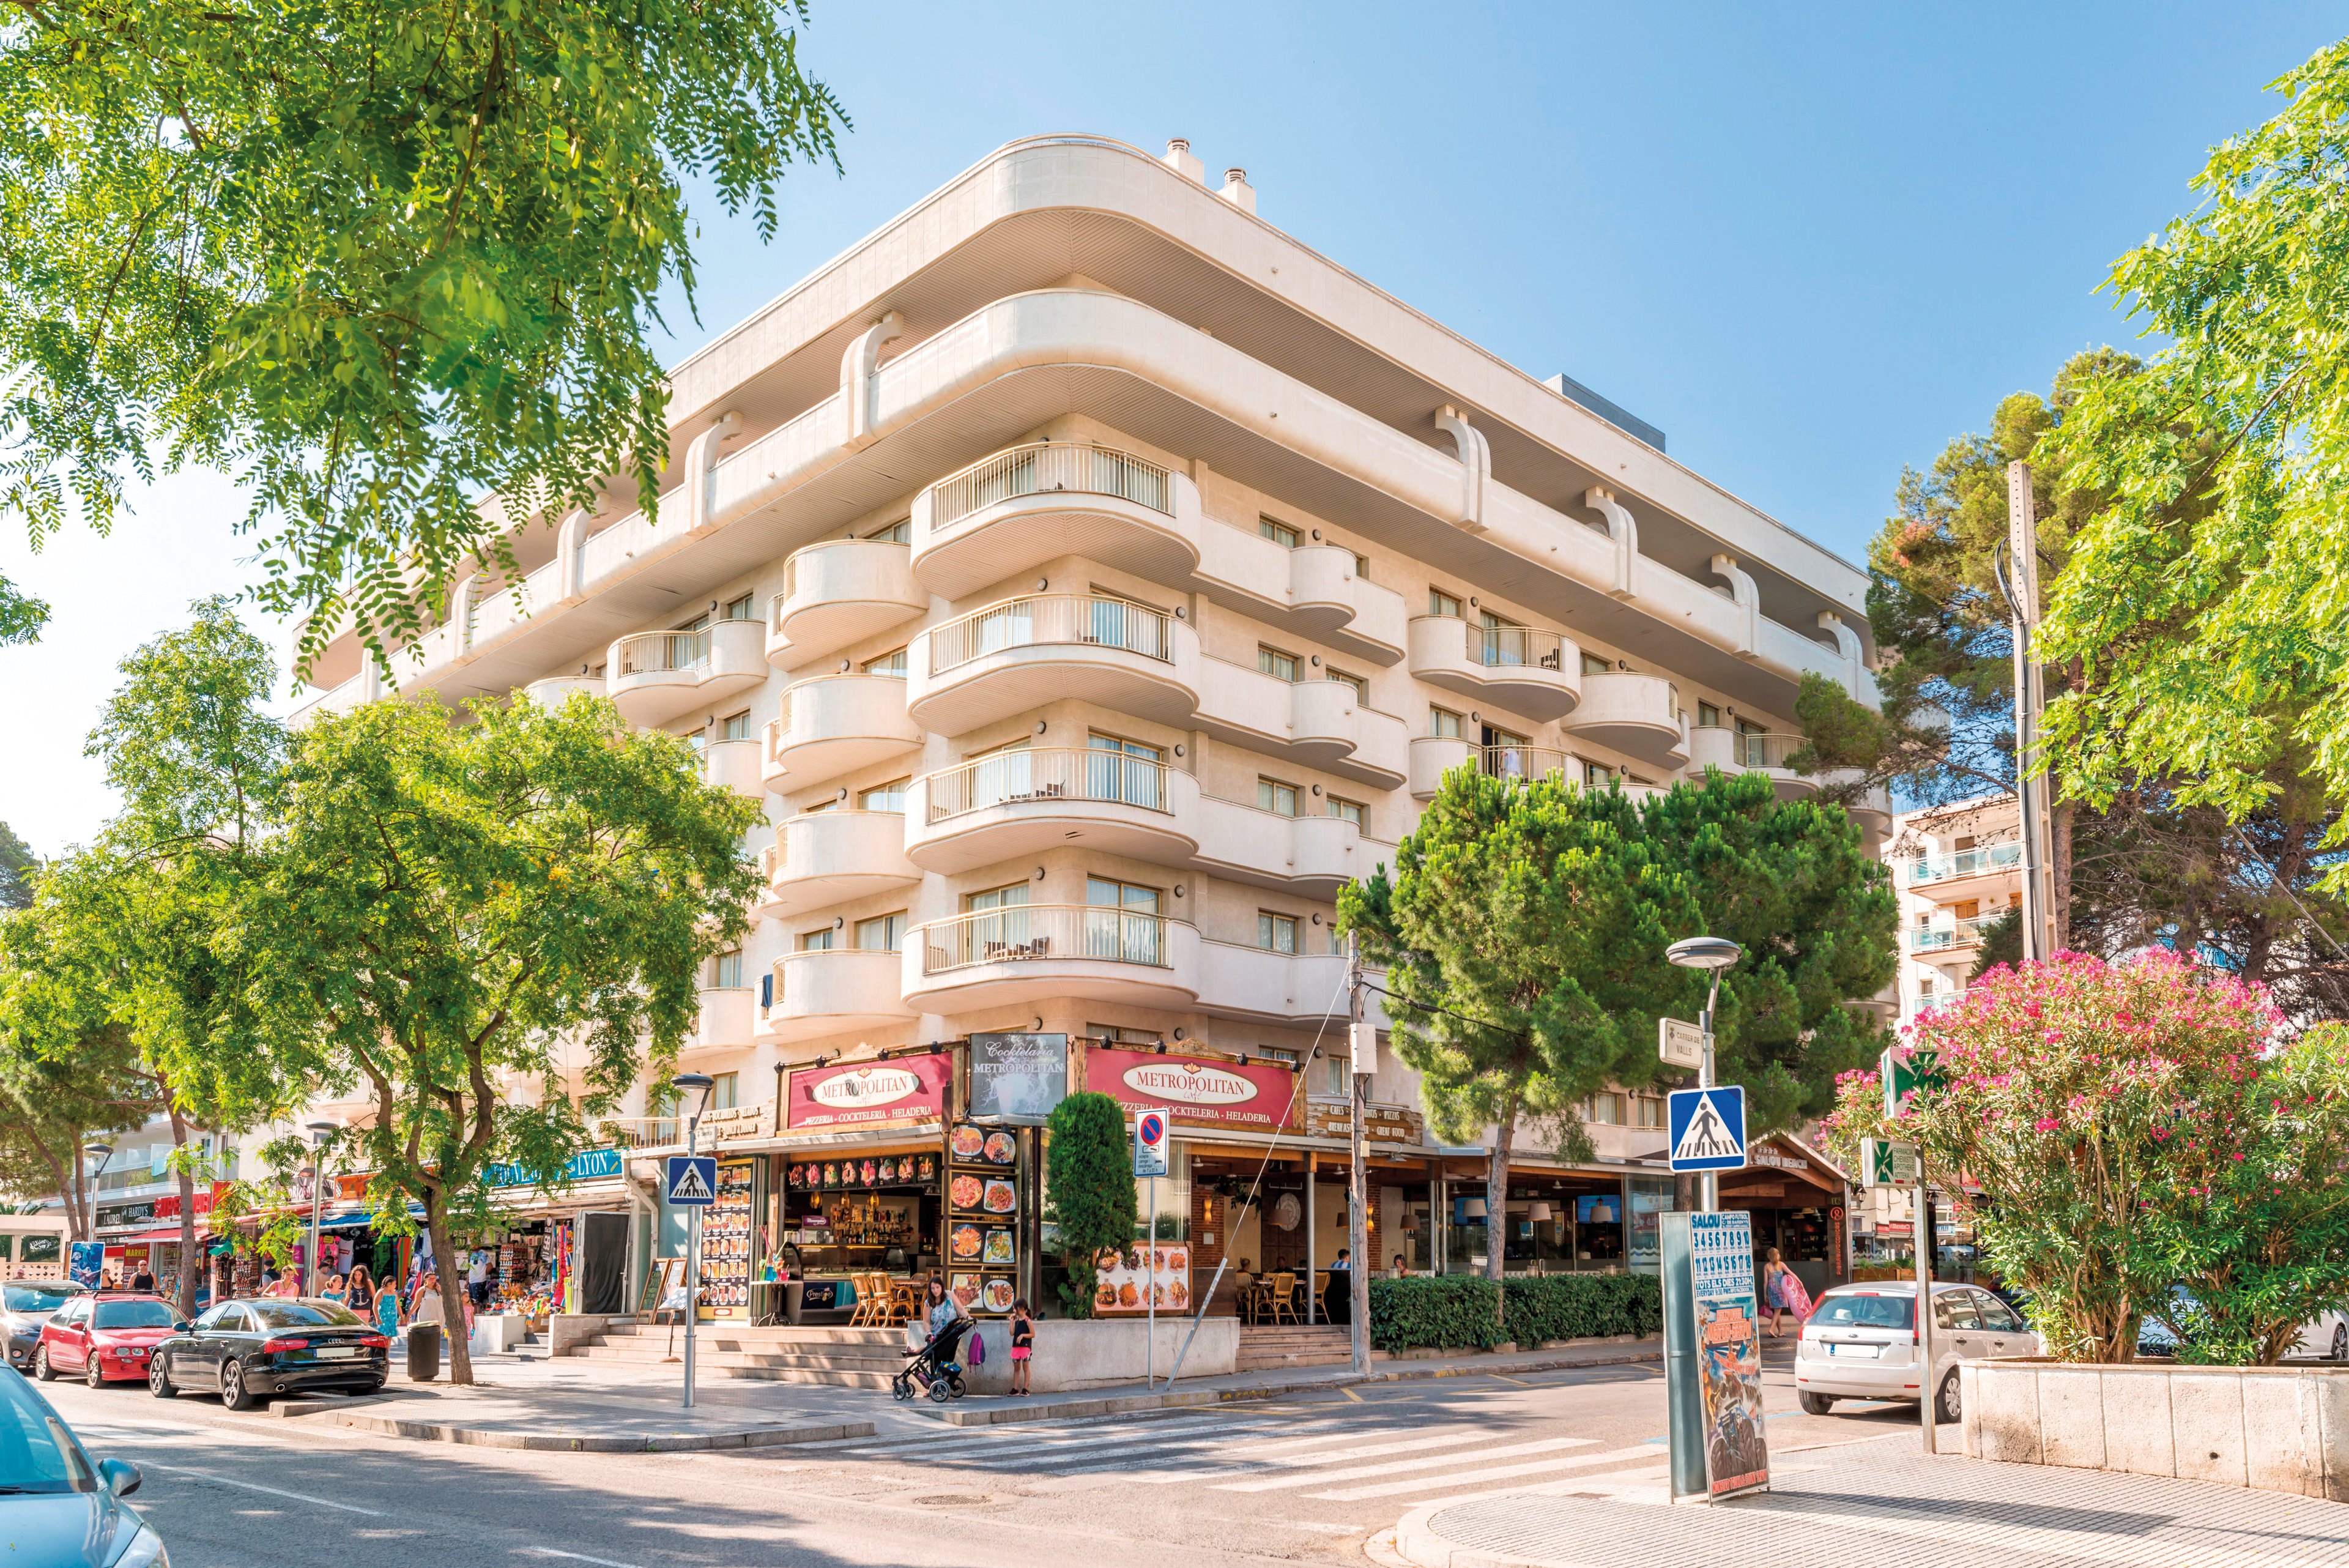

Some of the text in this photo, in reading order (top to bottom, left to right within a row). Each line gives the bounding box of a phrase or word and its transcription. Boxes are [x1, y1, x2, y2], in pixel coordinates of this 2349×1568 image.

[1677, 1031, 1693, 1042] CARRER
[1677, 1045, 1692, 1057] VALLS
[973, 1063, 1065, 1073] METROPOLITAN
[822, 1076, 908, 1099] METROPOLITAN
[1137, 1071, 1245, 1096] METROPOLITAN
[1183, 1088, 1202, 1102] café
[805, 1105, 932, 1126] PIZZERIA COCKTELERIA HELADERIA
[1226, 1112, 1271, 1123] HELADERIA
[1384, 1110, 1400, 1121] PIZZAS
[1377, 1126, 1390, 1136] GREAT
[1392, 1128, 1405, 1137] FOOD
[577, 1152, 607, 1176] LYON
[1754, 1154, 1781, 1167] SALOU
[1781, 1157, 1808, 1169] BEACH
[103, 1205, 149, 1225] LAUREL HARDY'S
[1691, 1214, 1720, 1229] SALOU
[1694, 1230, 1750, 1247] 3 4 5 6 7 8 9 10
[125, 1249, 147, 1257] MARKET
[1695, 1254, 1751, 1273] 11 12 13 14 15 16 17 18
[1696, 1280, 1710, 1290] TOTS
[1712, 1279, 1722, 1288] ELS
[1723, 1277, 1735, 1287] DIES
[1712, 1478, 1730, 1495] MONSTER
[1756, 1469, 1767, 1483] SHOW
